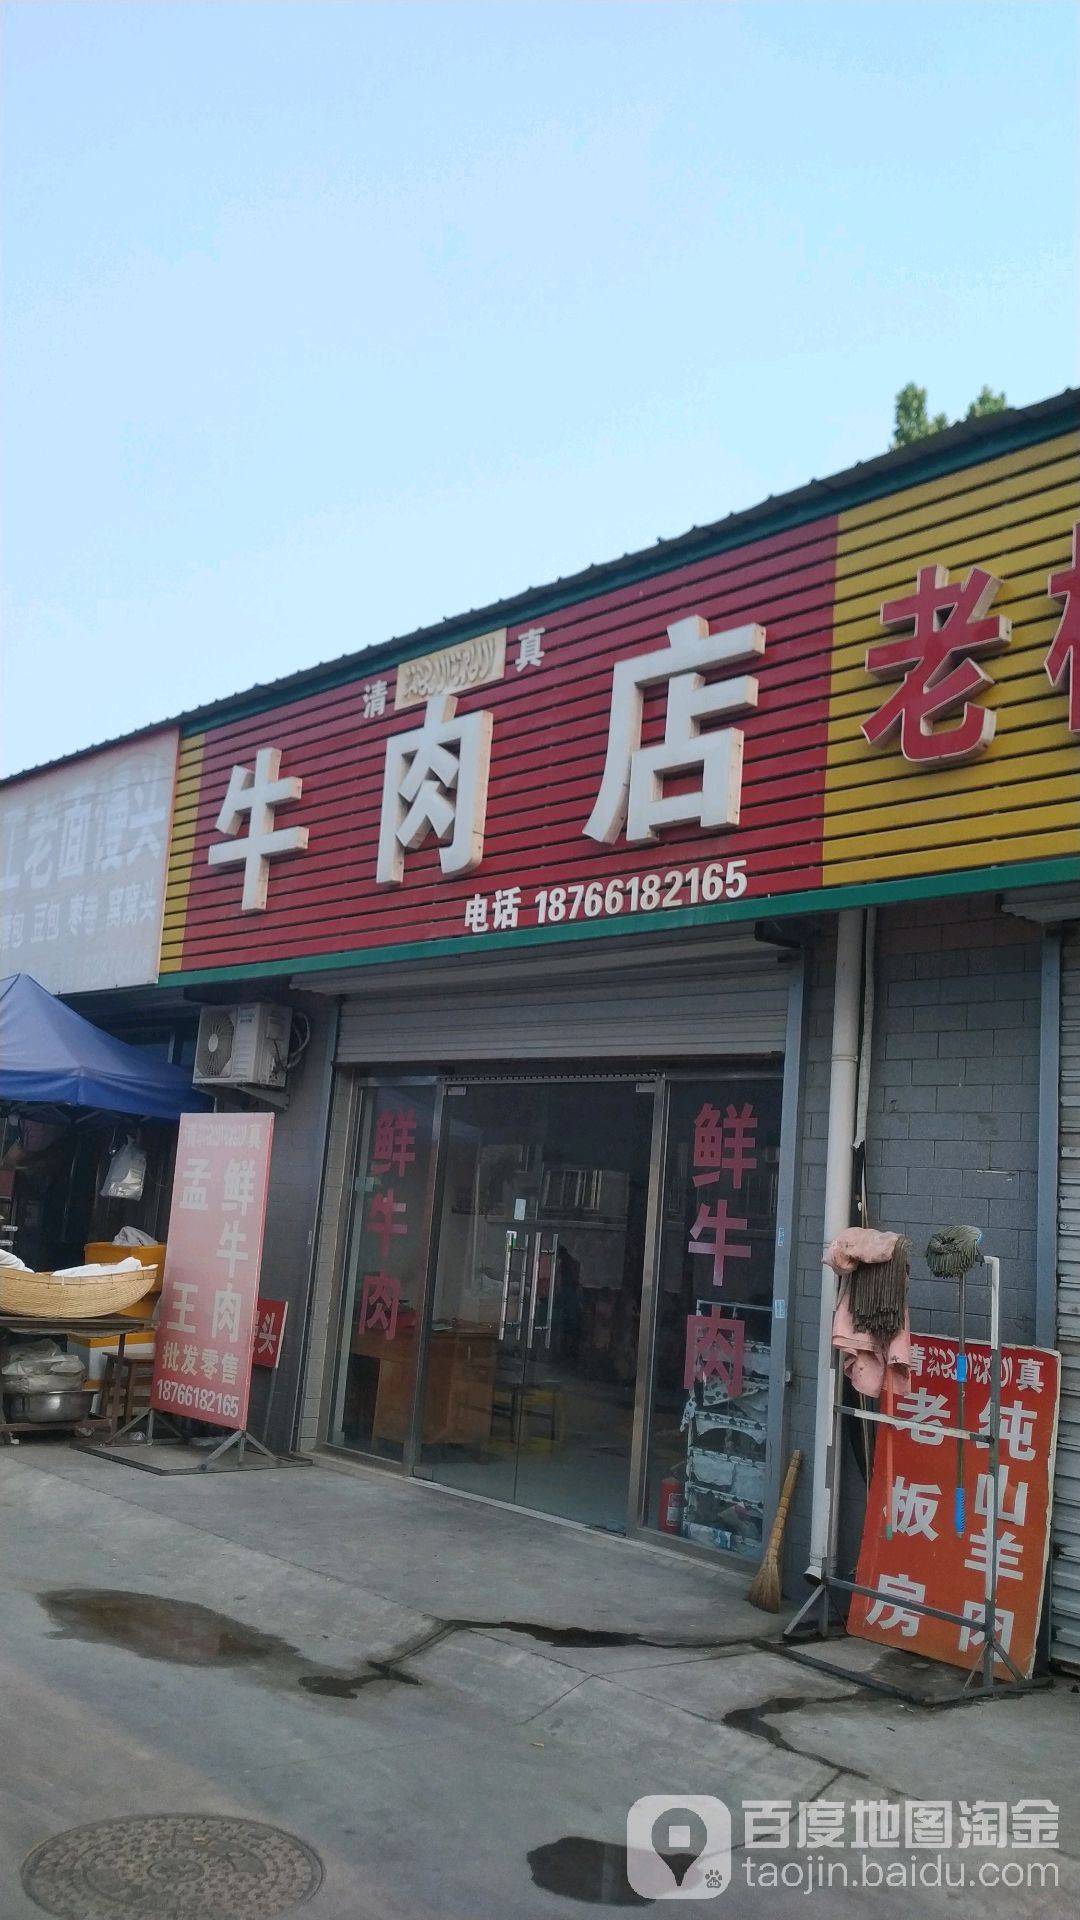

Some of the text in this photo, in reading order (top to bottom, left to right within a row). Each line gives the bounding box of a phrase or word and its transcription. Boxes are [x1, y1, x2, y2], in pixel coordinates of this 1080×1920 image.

[363, 680, 388, 719] 清
[515, 627, 545, 672] 真
[861, 520, 1080, 763] 老
[208, 615, 766, 912] 牛肉店
[465, 860, 748, 932] 电话 18766182165
[212, 1158, 256, 1344] 鲜牛肉
[359, 1106, 416, 1340] 鲜牛肉
[684, 1102, 757, 1398] 鲜牛肉
[157, 1379, 239, 1419] 18766182165
[162, 1342, 240, 1386] 批发零售
[1016, 1358, 1044, 1394] 真
